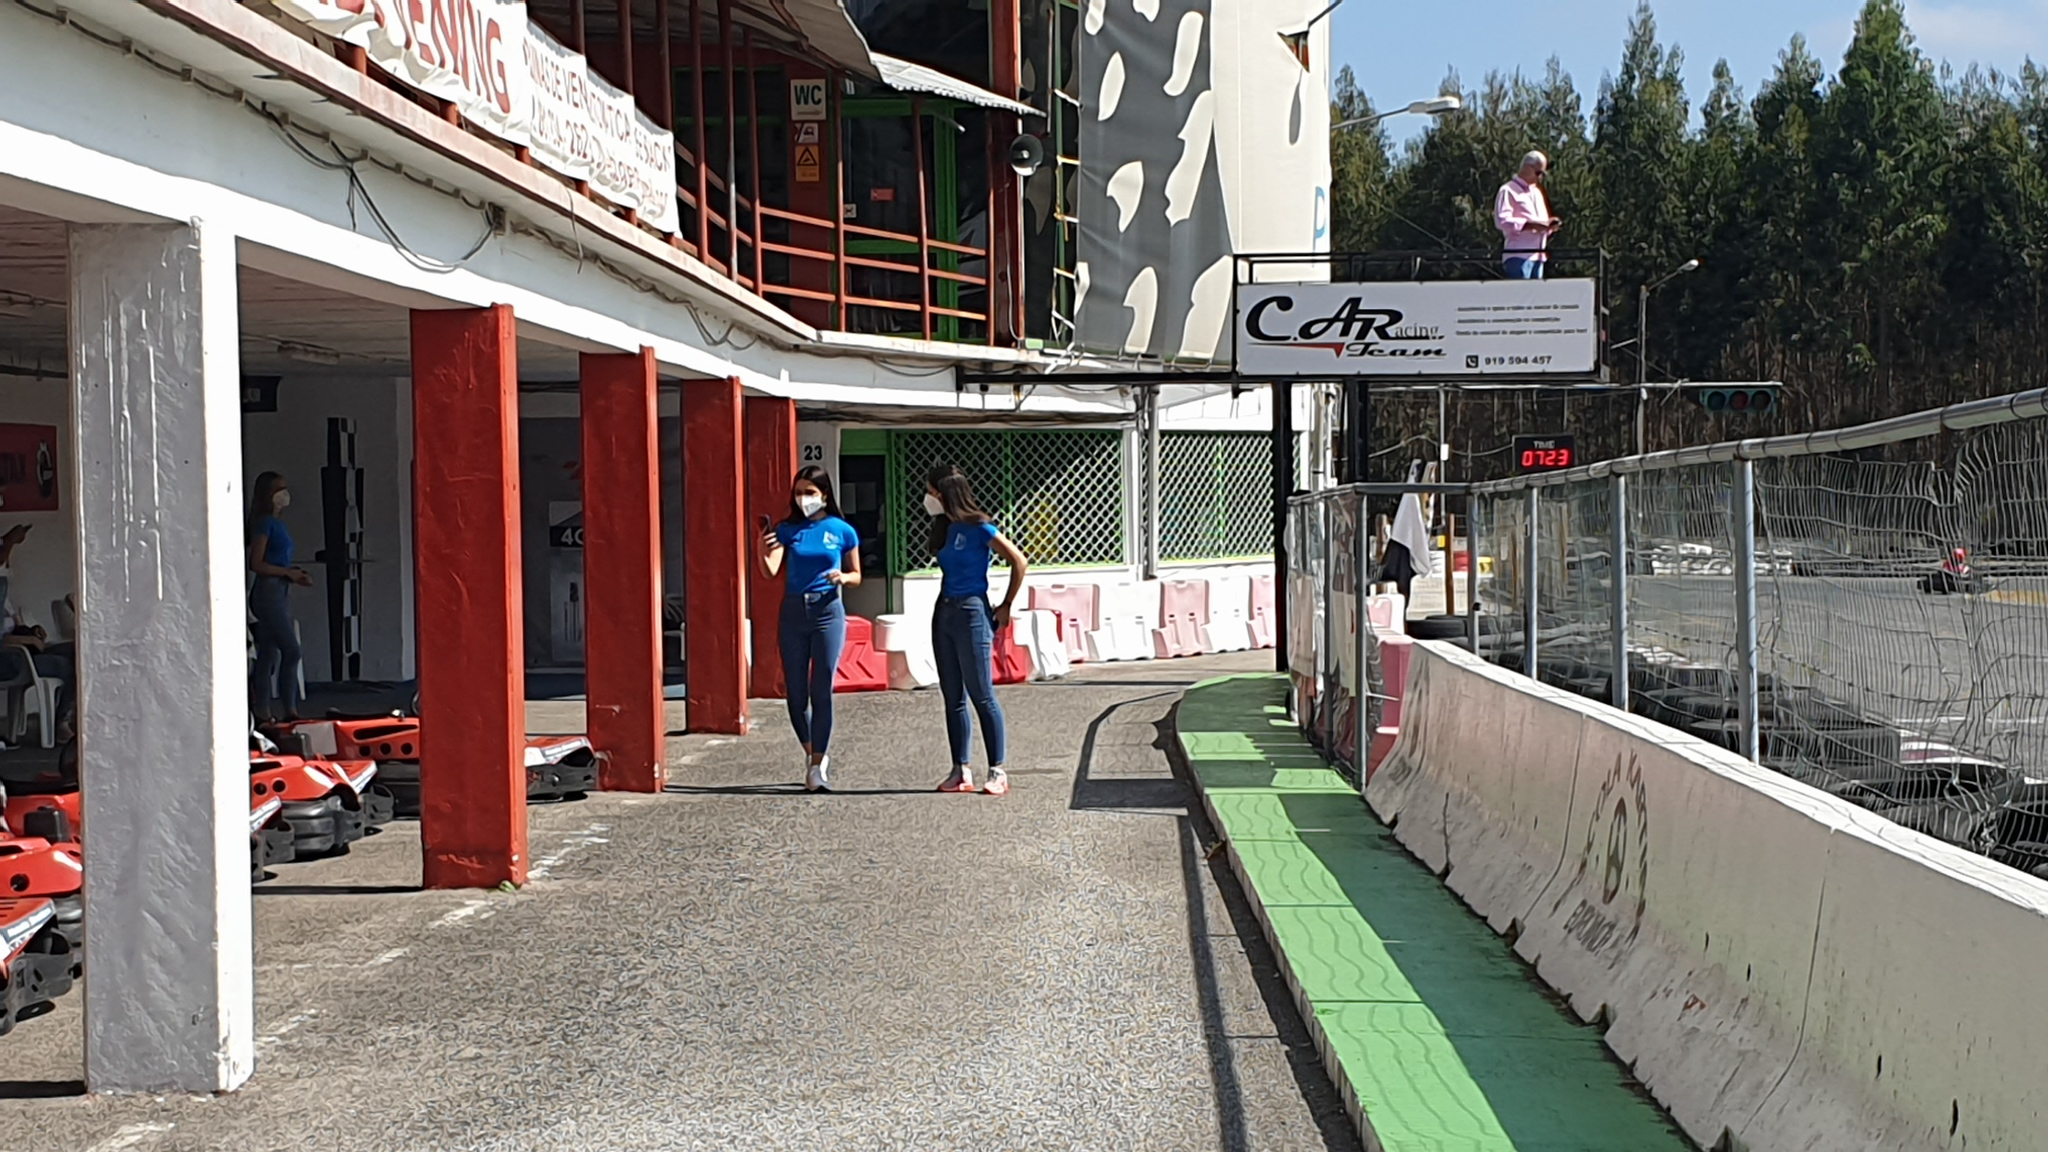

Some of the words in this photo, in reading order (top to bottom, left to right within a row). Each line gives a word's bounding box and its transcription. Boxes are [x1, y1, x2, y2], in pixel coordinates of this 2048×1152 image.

[794, 84, 822, 106] WC
[1345, 342, 1447, 359] Team
[804, 444, 823, 461] 23
[1533, 440, 1555, 449] TIME
